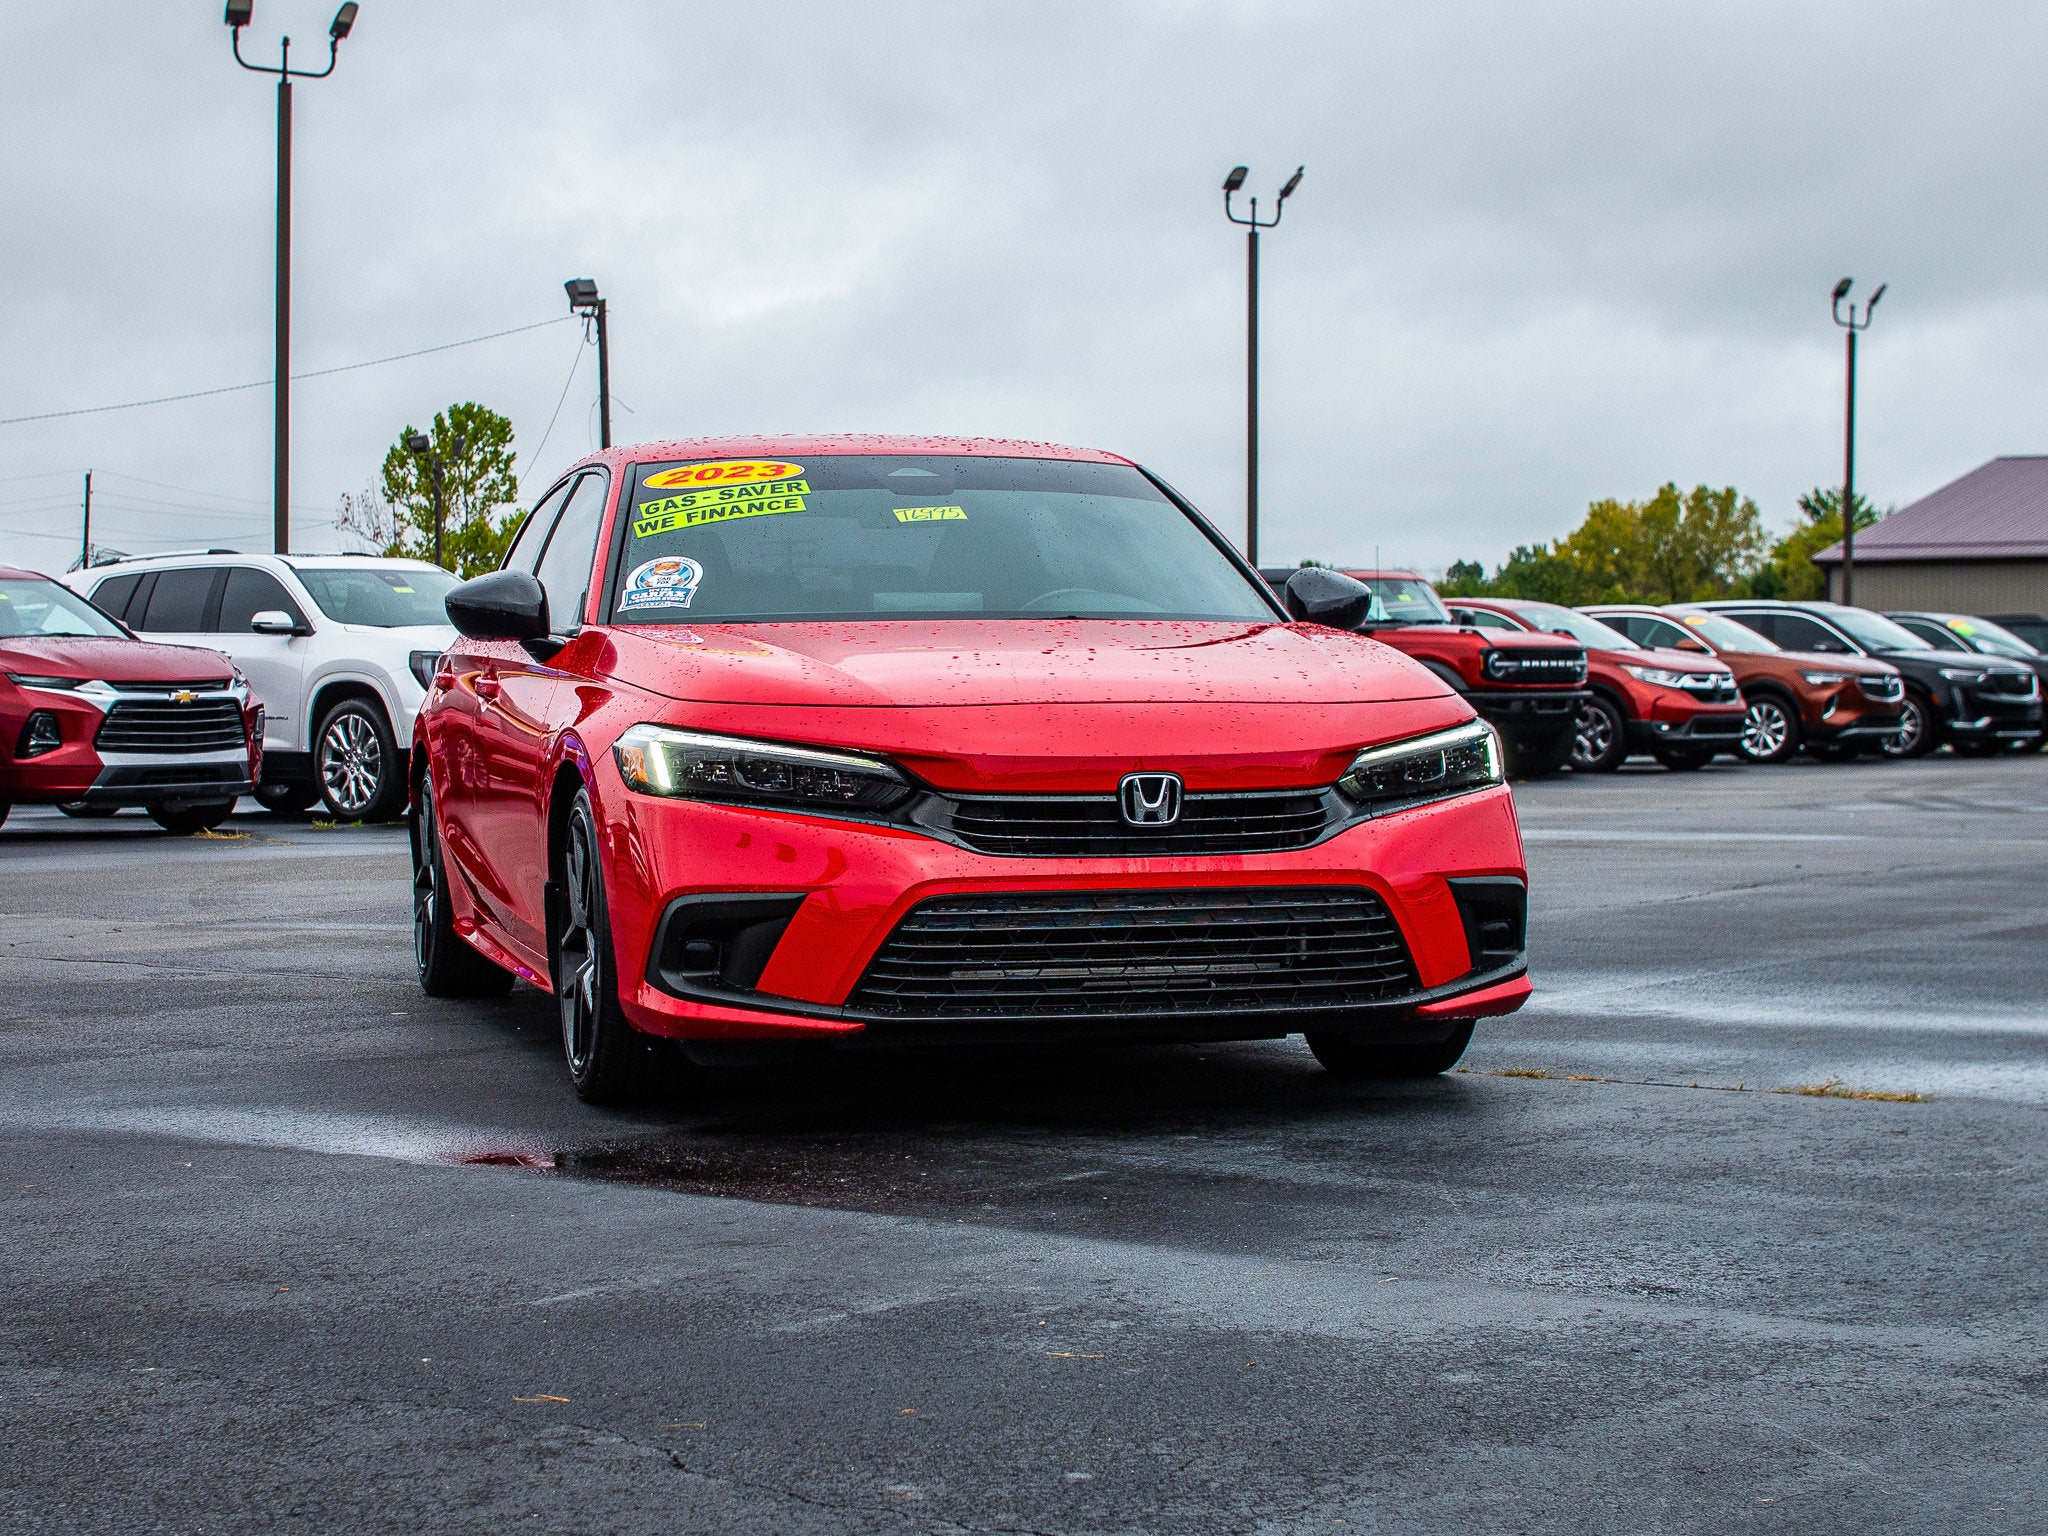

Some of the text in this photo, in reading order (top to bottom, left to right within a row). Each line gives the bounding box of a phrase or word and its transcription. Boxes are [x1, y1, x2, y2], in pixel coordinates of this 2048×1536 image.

[661, 464, 787, 486] 2023
[637, 498, 799, 534] WE FINANCE
